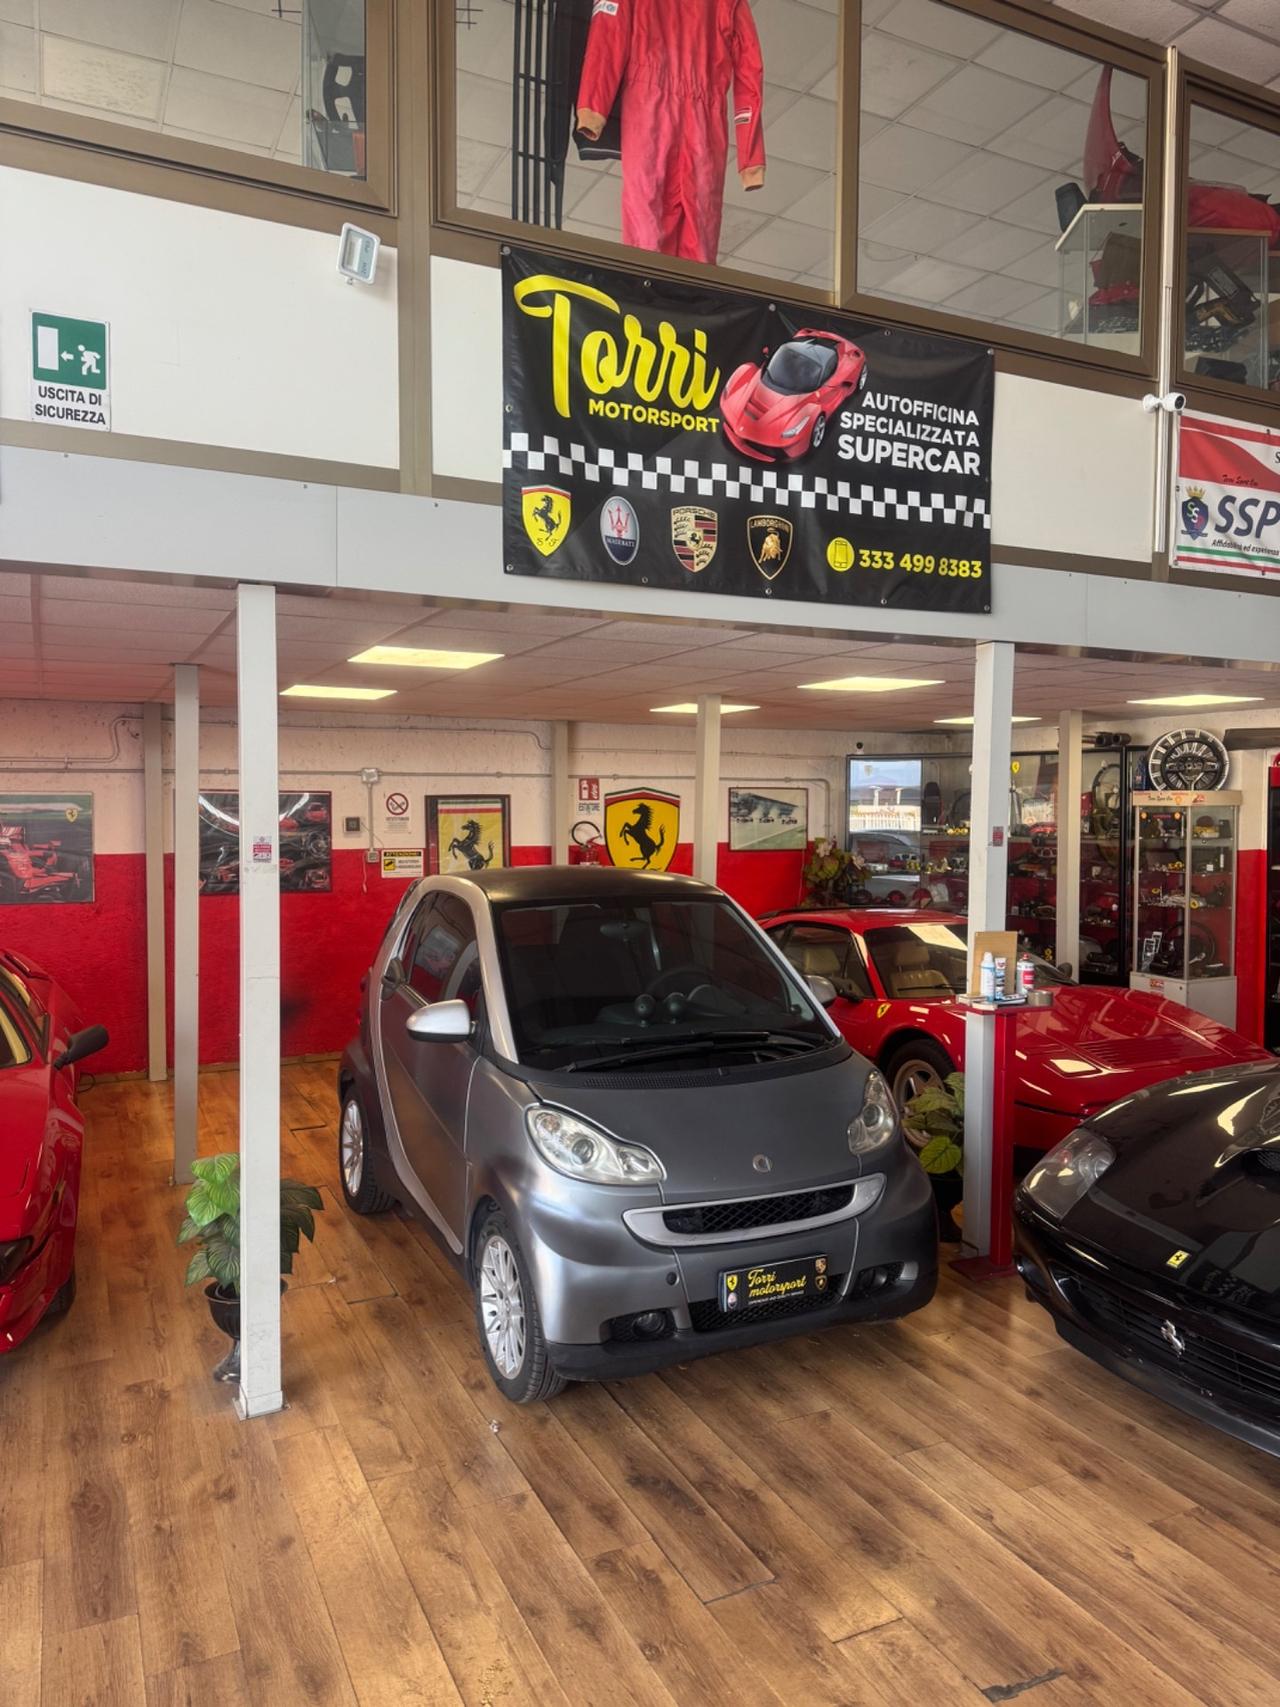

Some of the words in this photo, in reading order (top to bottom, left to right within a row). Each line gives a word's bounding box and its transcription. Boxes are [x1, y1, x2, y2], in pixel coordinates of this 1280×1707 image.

[513, 274, 721, 418] Torri
[38, 385, 85, 404] USCITA
[89, 393, 102, 406] DI
[862, 391, 980, 426] AUTOFFICINA
[35, 403, 106, 425] SICUREZZA
[588, 398, 720, 433] MOTORSPORT
[839, 411, 980, 447] SPECIALIZZATA
[837, 434, 981, 476] SUPERCAR
[672, 506, 716, 519] PORSCHE
[858, 549, 895, 570] 333
[899, 553, 935, 574] 499
[938, 557, 983, 579] 8383
[748, 1268, 777, 1287] Torri
[749, 1275, 807, 1298] motorsport
